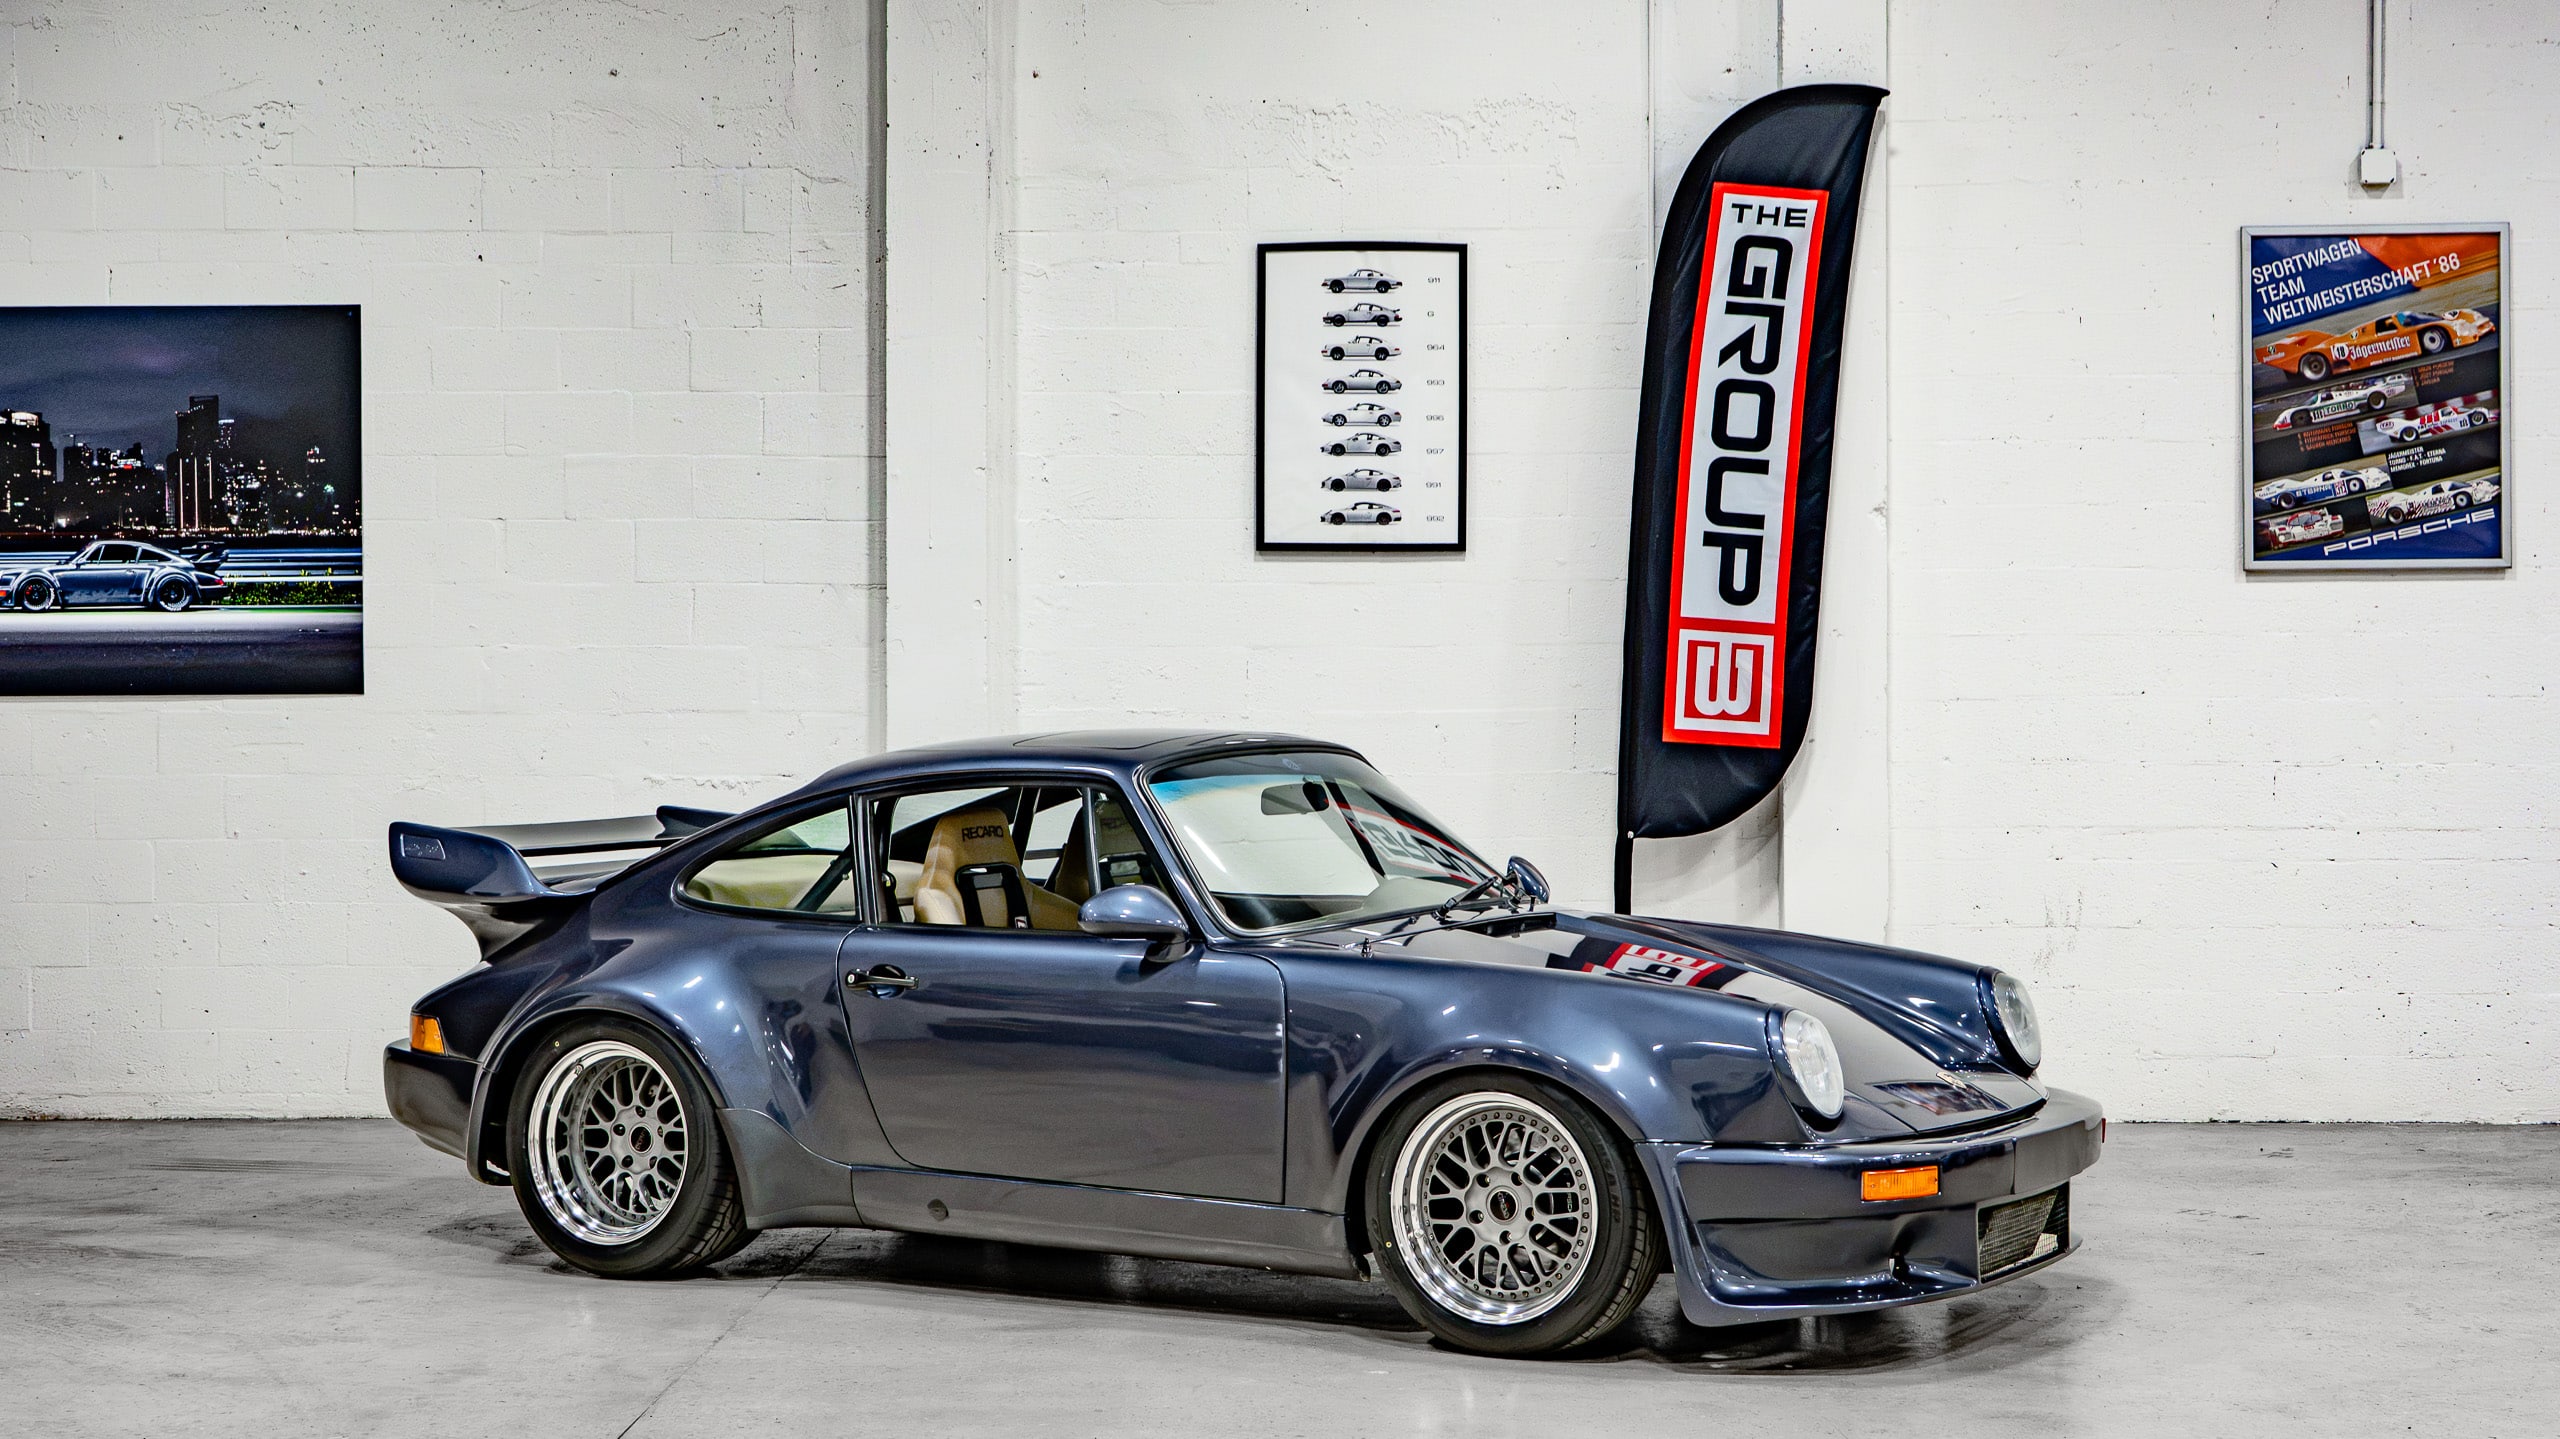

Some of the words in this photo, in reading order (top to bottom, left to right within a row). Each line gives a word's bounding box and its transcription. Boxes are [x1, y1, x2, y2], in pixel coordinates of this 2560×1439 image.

[1731, 202, 1808, 228] THE
[2252, 238, 2362, 285] SPORTWAGEN
[2257, 277, 2306, 305] TEAM
[2263, 261, 2431, 325] WELTMEISTERSCHAFT
[1702, 235, 1793, 607] GROUP
[2323, 508, 2496, 557] PORSCHE
[961, 825, 1004, 842] RECARO
